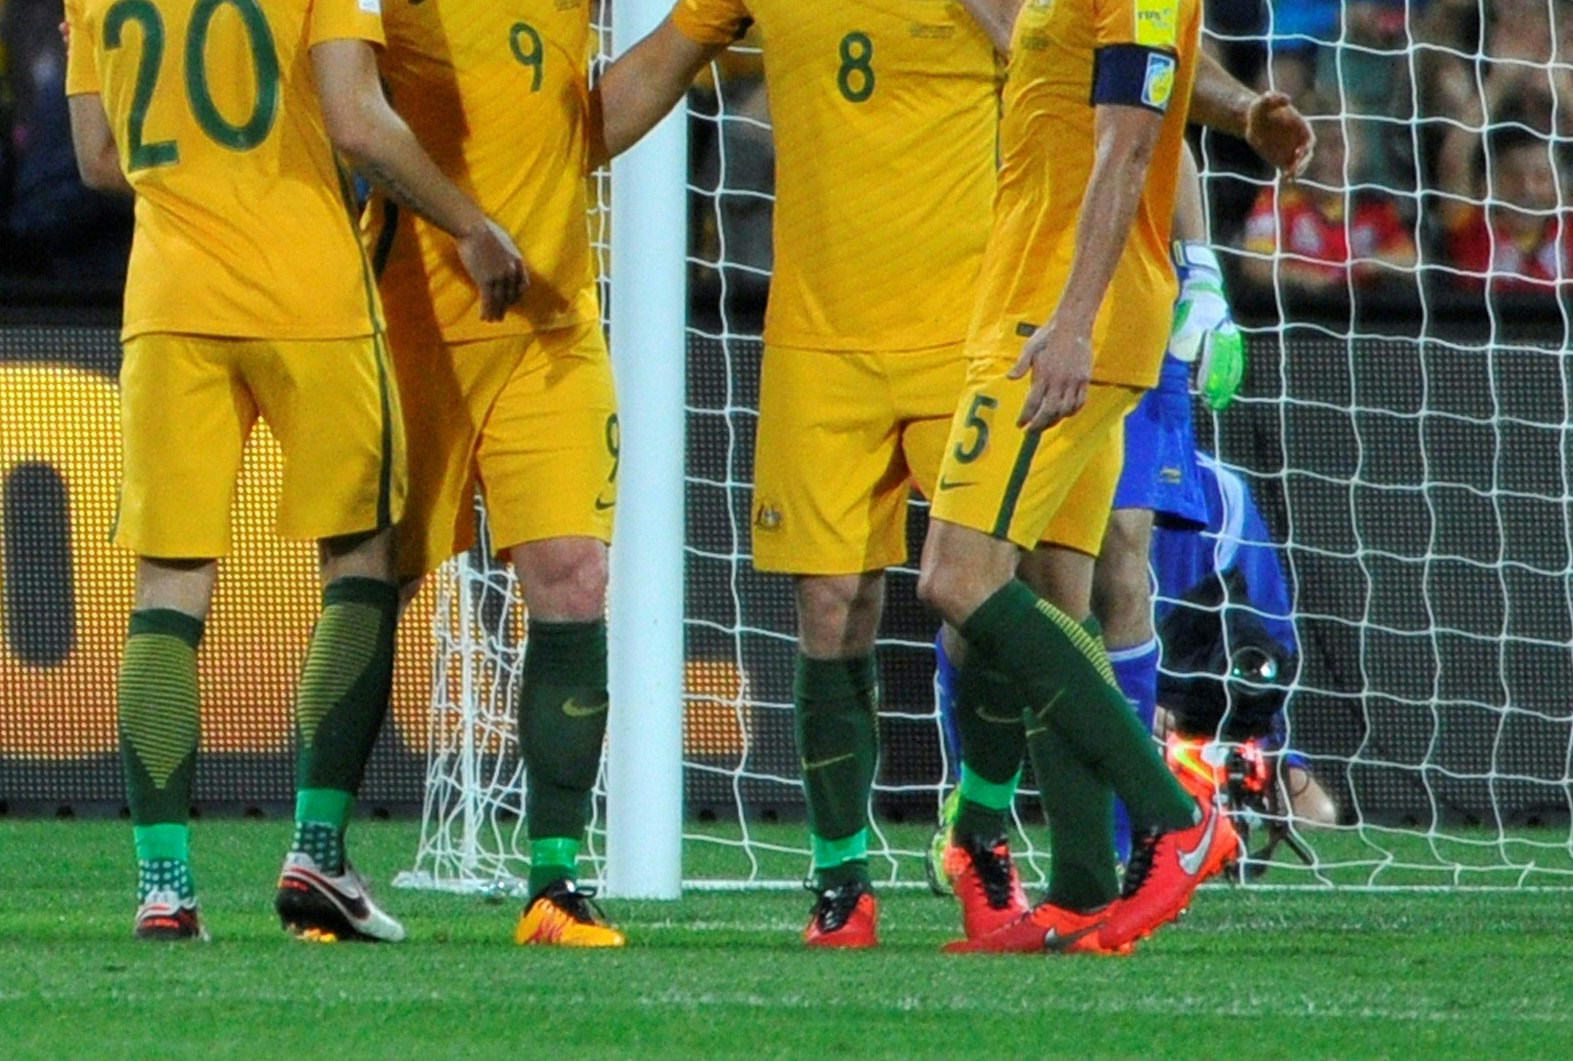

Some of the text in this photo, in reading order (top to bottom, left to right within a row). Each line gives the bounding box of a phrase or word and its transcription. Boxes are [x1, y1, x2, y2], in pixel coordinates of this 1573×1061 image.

[509, 22, 544, 94] 9
[837, 31, 875, 104] 8
[953, 392, 999, 465] 5
